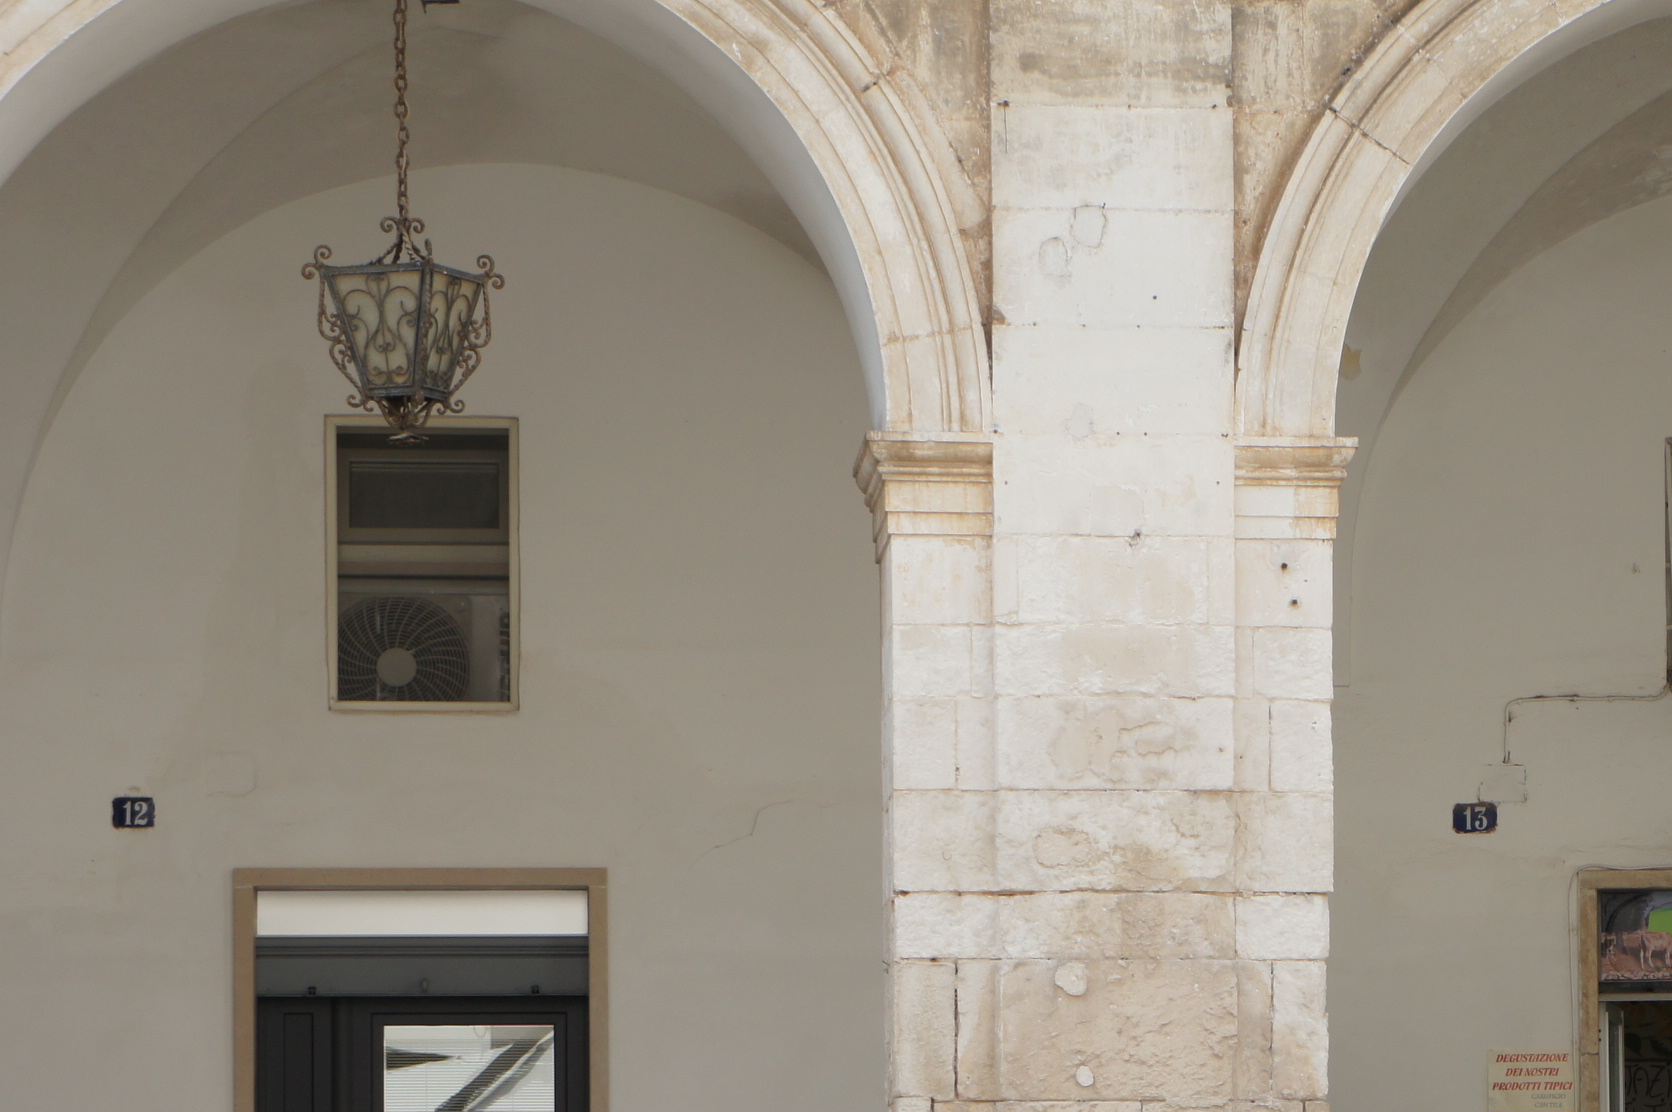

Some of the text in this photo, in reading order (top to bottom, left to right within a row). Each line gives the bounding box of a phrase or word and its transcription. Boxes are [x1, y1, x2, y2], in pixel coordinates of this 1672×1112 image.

[123, 801, 148, 825] 12
[1463, 806, 1488, 830] 13
[1496, 1054, 1568, 1062] DEGUSTAZIONE
[1506, 1068, 1559, 1076] DEI NOSTRI
[1492, 1082, 1573, 1090] PRODOTTI TIPICI
